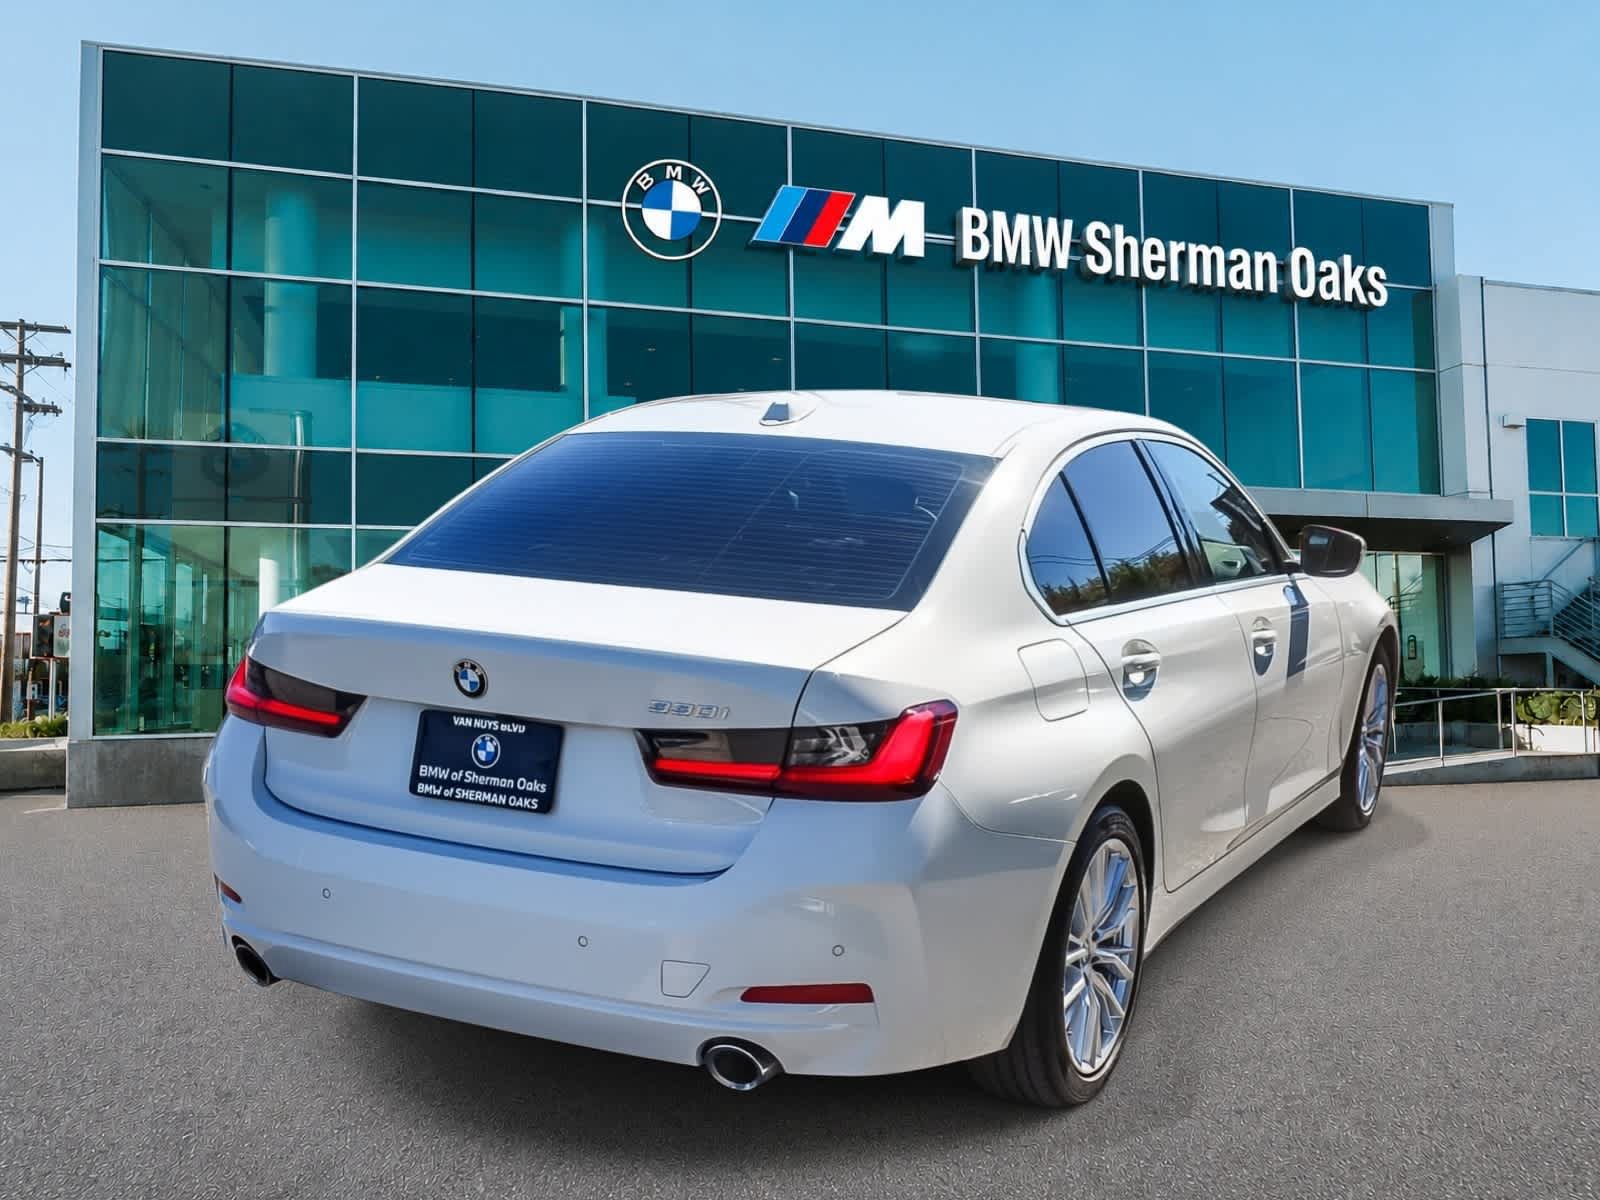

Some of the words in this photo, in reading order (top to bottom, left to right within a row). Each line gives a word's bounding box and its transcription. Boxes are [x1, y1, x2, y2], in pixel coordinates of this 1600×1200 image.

[636, 165, 711, 195] BMW
[835, 194, 925, 258] M
[960, 206, 1073, 270] BMW
[1085, 220, 1278, 294] Sherman
[1290, 246, 1388, 308] Oaks
[453, 715, 473, 727] VAN
[473, 718, 499, 731] NUYS
[500, 722, 526, 733] BLVD
[419, 764, 450, 780] BMW
[451, 769, 463, 781] of
[464, 771, 514, 788] Sherman
[516, 777, 547, 793] Oaks
[417, 782, 442, 795] BMW
[443, 787, 454, 798] of
[455, 788, 506, 805] SHERMAN
[508, 795, 539, 810] OAKS
